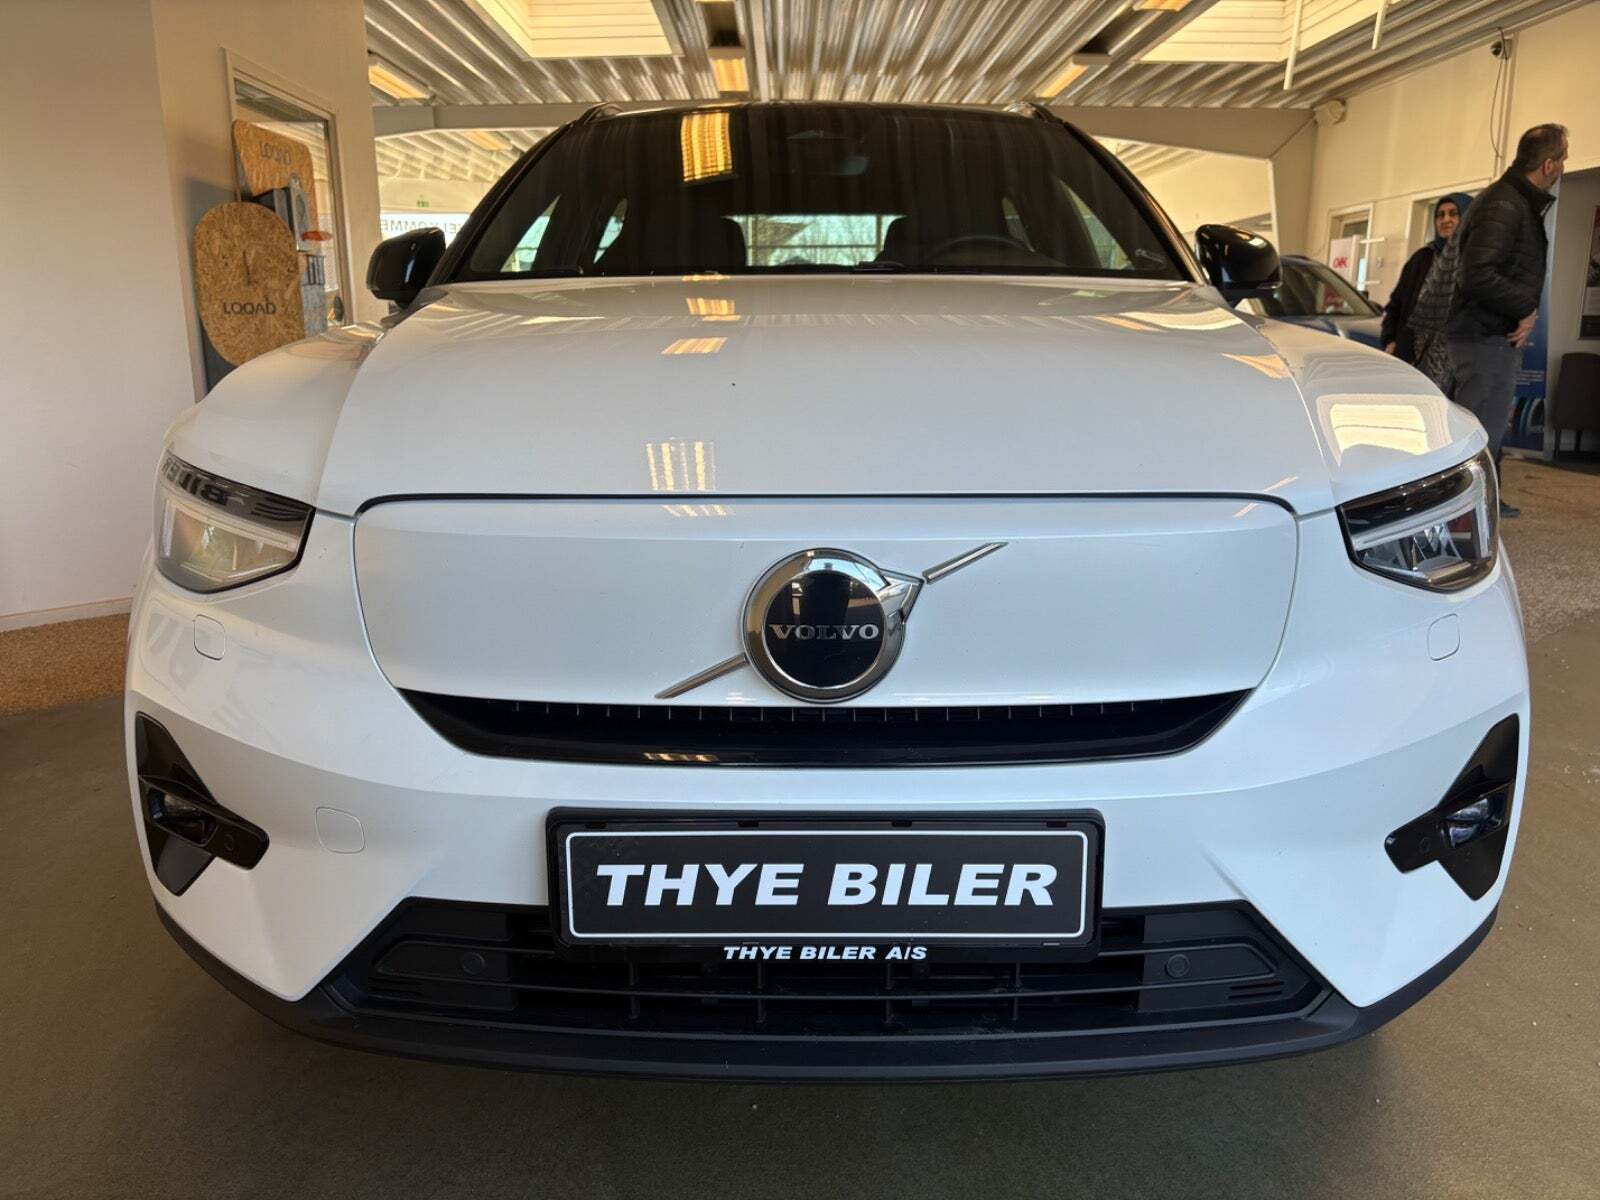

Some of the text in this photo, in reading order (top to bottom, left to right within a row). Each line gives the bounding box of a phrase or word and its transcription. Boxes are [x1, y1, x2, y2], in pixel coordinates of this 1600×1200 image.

[769, 623, 880, 641] VOLVO
[596, 863, 1058, 906] THYE BILER
[723, 946, 928, 960] THYE BILER A/S
